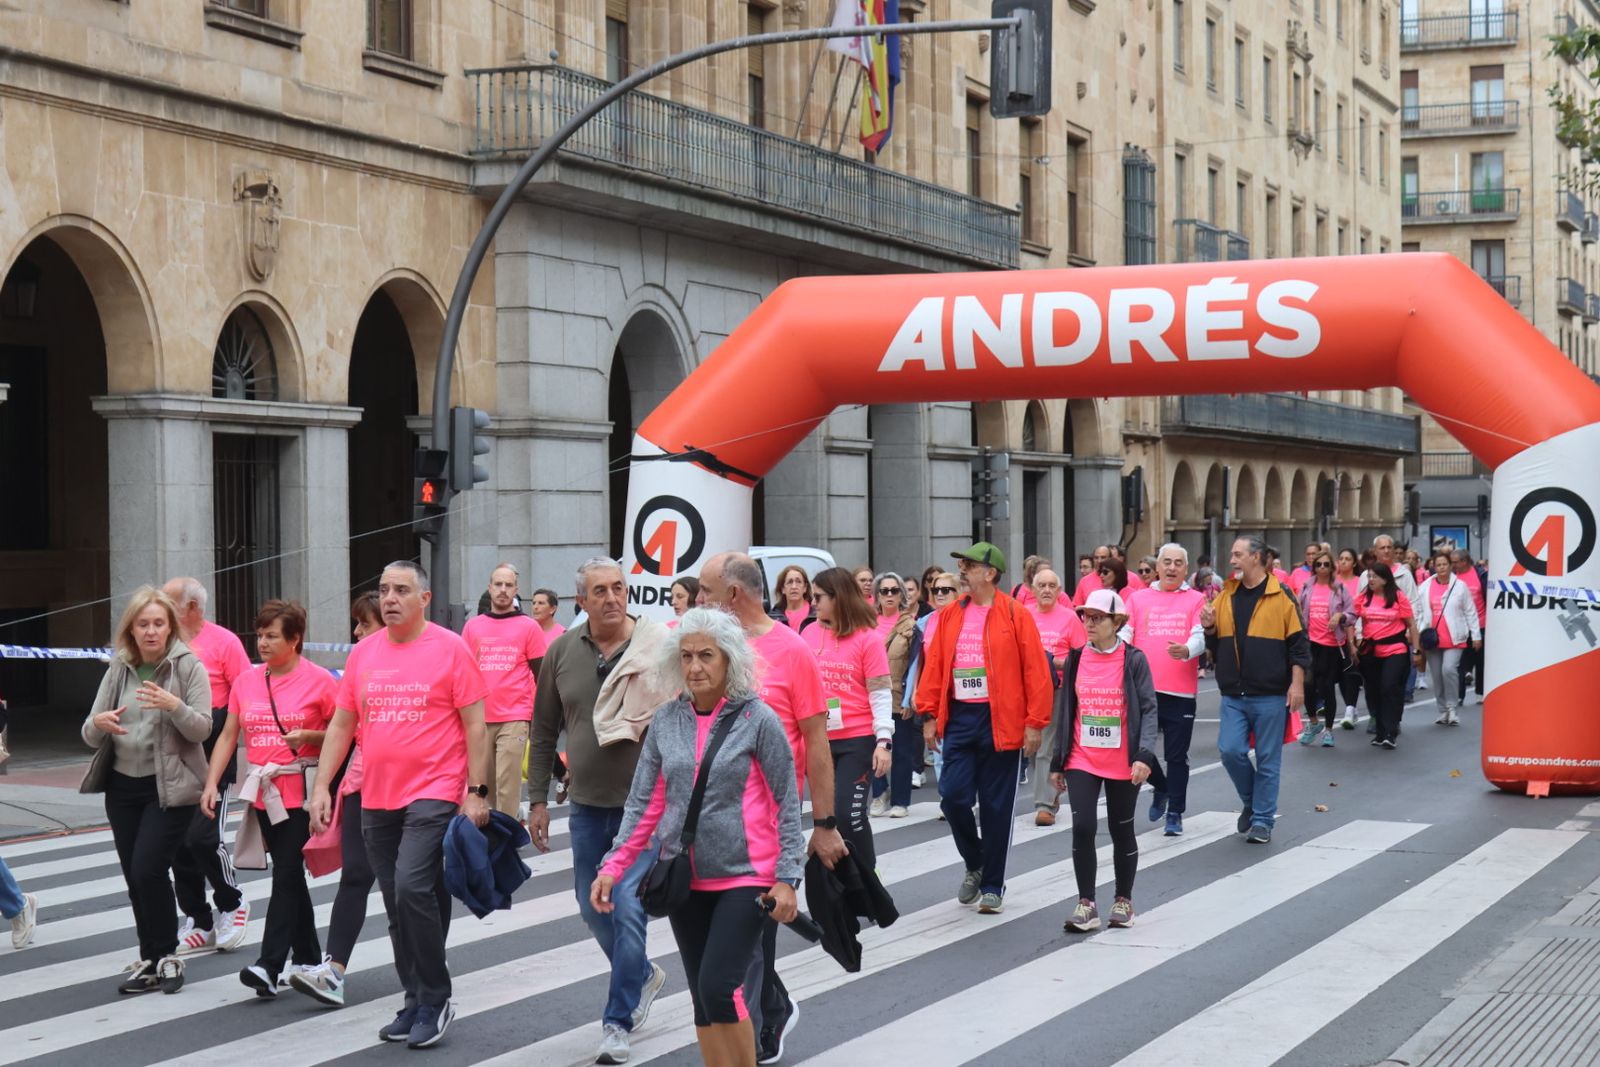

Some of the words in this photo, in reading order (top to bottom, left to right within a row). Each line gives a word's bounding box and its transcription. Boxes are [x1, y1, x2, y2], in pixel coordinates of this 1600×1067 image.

[877, 276, 1321, 372] ANDRÉS
[628, 584, 674, 607] NDR
[1494, 588, 1600, 611] ANDR
[955, 642, 983, 650] contr
[956, 650, 984, 662] cánc
[367, 682, 382, 692] En
[384, 681, 431, 692] marcha
[823, 681, 854, 692] ncer
[962, 678, 982, 689] 6186
[1079, 685, 1090, 694] En
[366, 695, 411, 706] contra
[413, 694, 427, 706] el
[1079, 695, 1113, 705] contra
[245, 712, 259, 721] En
[260, 711, 305, 721] mrcha
[368, 706, 427, 722] cáncer
[1089, 726, 1111, 738] 6185
[250, 733, 287, 747] cánc
[1487, 755, 1600, 767] www.grupoandres.com
[850, 784, 865, 832] JORDAN
